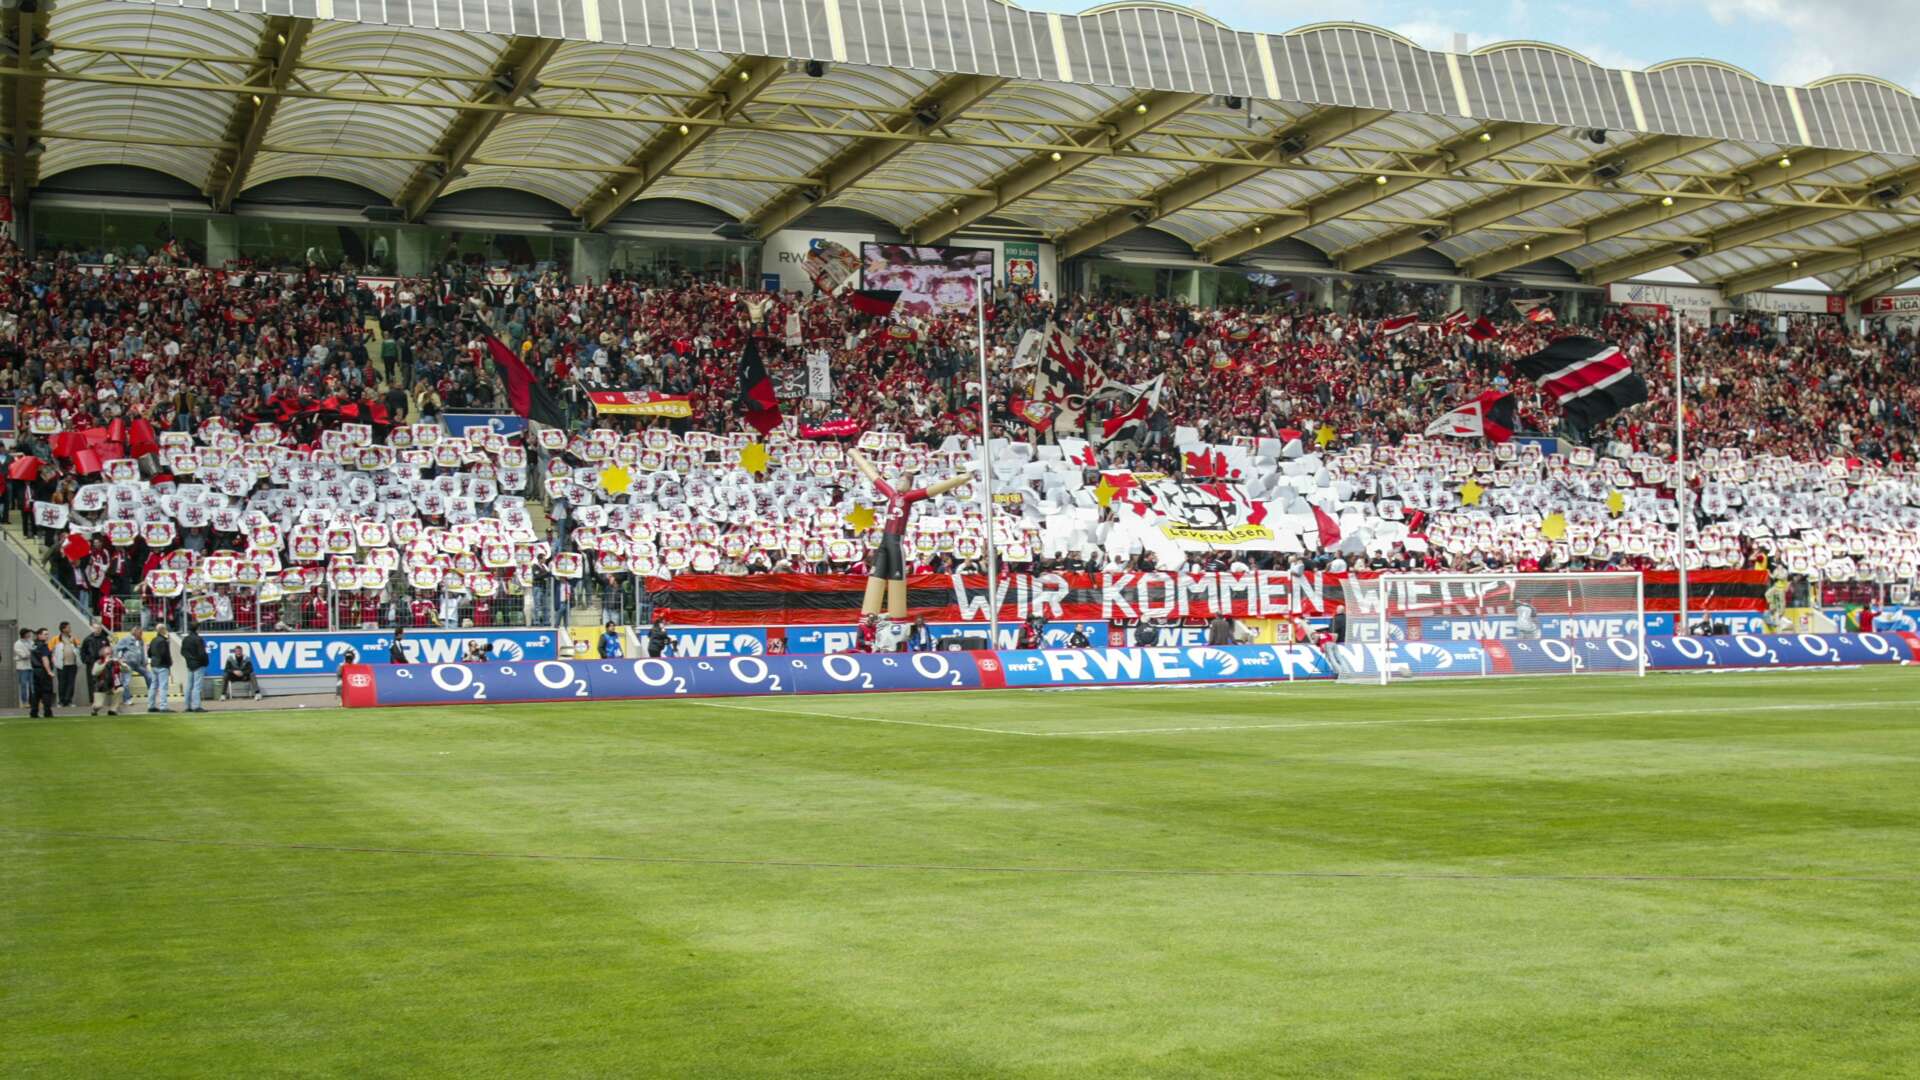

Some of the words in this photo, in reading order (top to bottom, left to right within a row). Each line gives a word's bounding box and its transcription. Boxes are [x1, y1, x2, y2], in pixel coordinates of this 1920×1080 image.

[779, 252, 806, 263] RW
[1645, 286, 1671, 304] EVL
[1169, 527, 1267, 541] Leverkusen
[951, 573, 1069, 620] WIR
[1102, 570, 1324, 619] KOMMEN
[1452, 620, 1518, 640] RWE
[1561, 619, 1624, 639] RWE
[640, 634, 731, 657] WE
[1539, 639, 1584, 668] O2
[1672, 636, 1716, 666] O2
[1735, 635, 1779, 663] O2
[1798, 634, 1840, 662] O2
[1858, 633, 1900, 661] O2
[1008, 663, 1037, 672] RWE
[1042, 648, 1191, 681] RWE
[1243, 657, 1268, 666] RWE
[431, 663, 486, 699] O2
[533, 661, 589, 696] O2
[633, 658, 687, 693] O2
[729, 656, 782, 690] O2
[822, 654, 874, 688] O2
[911, 652, 962, 686] O2
